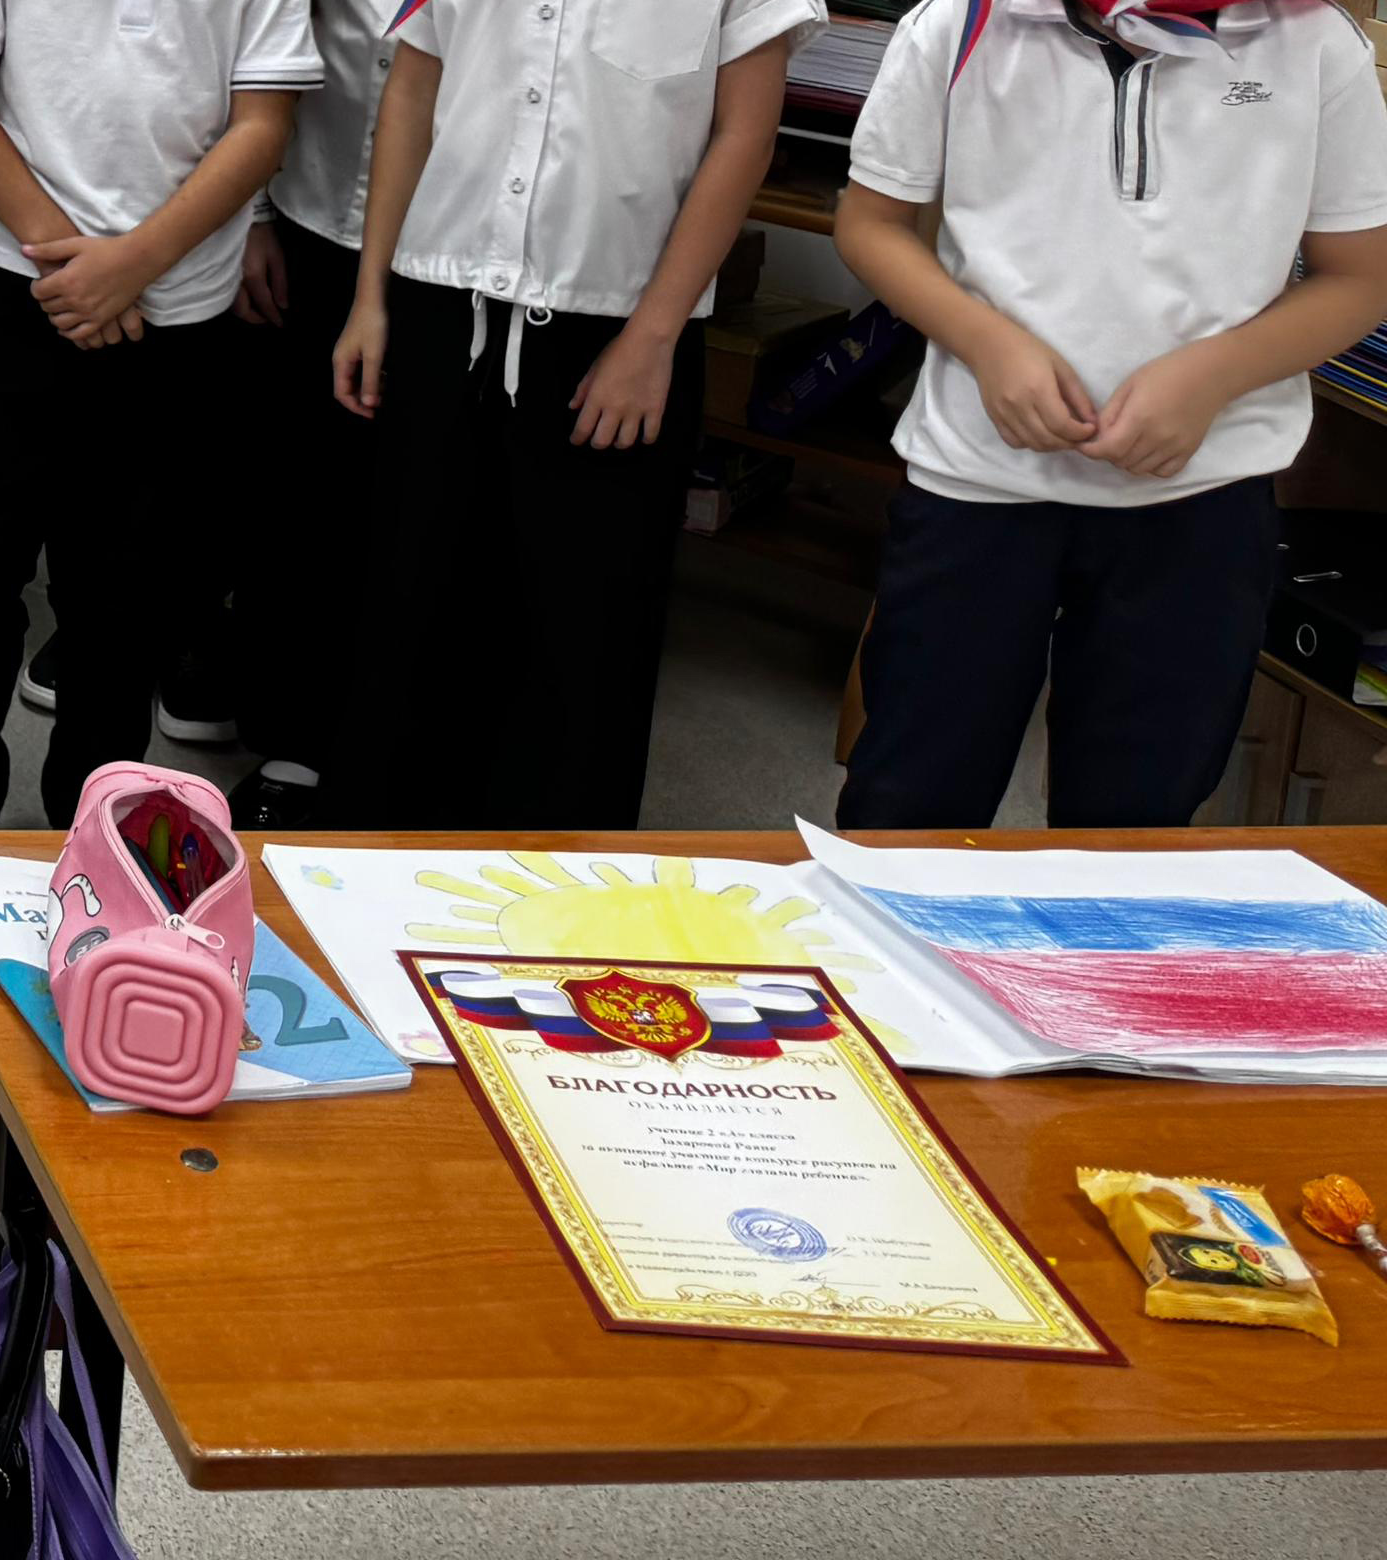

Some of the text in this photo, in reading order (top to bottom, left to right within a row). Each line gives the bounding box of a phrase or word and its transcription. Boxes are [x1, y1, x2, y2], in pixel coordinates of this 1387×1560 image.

[546, 1075, 837, 1101] БЛАГОДАРНОСТЬ
[629, 1100, 783, 1116] ОБЪЯВЛЯЕТСЯ
[647, 1126, 704, 1137] ученице
[748, 1132, 797, 1141] класса
[811, 1159, 877, 1172] рисунков
